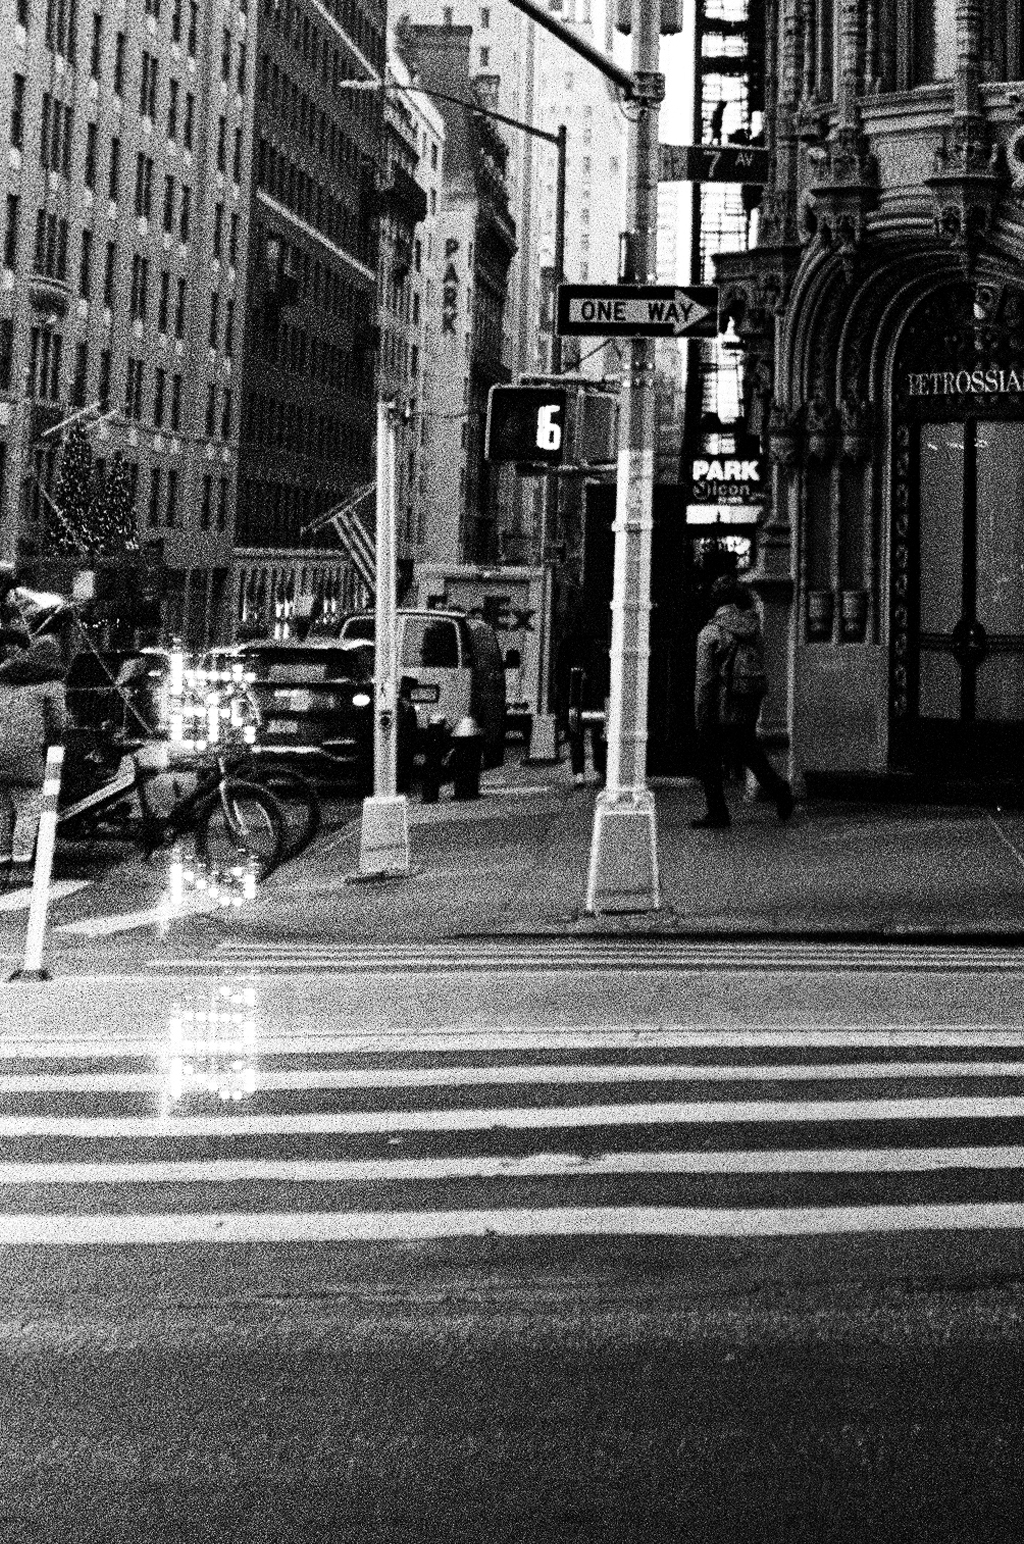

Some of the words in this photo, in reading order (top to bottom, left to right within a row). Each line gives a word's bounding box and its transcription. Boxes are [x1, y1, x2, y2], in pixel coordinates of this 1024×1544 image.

[703, 150, 720, 177] 7
[735, 152, 753, 166] AV
[441, 237, 460, 335] PARK
[581, 301, 626, 321] ONE
[648, 302, 694, 322] WAY
[536, 404, 561, 451] 6
[692, 460, 759, 481] PARK
